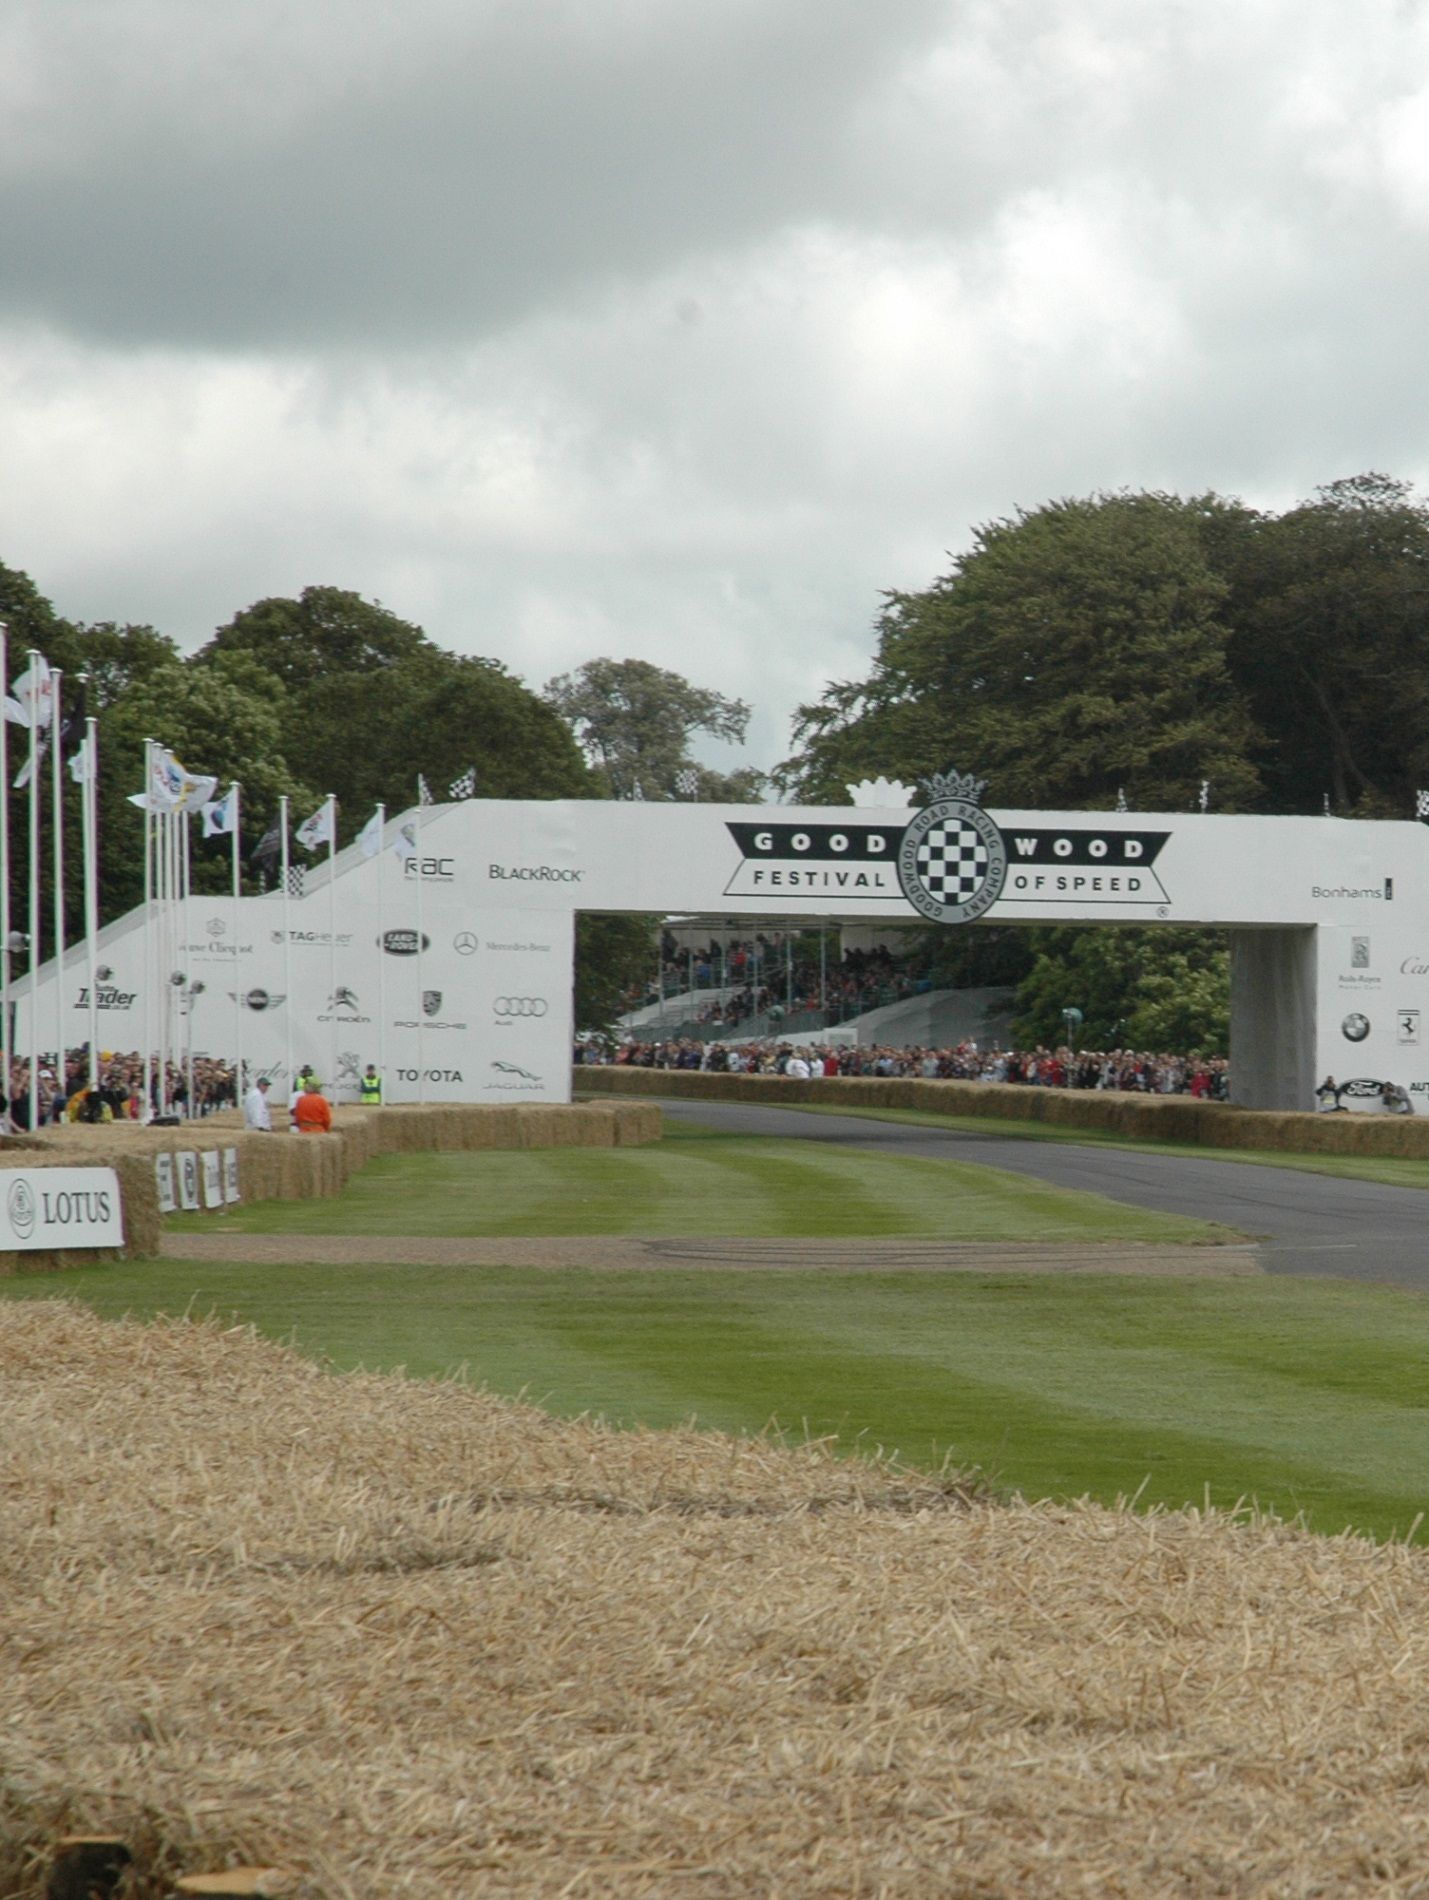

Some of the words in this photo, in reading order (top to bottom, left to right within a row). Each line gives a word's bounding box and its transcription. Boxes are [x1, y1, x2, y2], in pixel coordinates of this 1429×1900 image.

[914, 804, 949, 833] ROAD
[957, 804, 1000, 849] RACING
[753, 871, 885, 887] FESTIVAL
[1014, 875, 1045, 890] OF
[1056, 876, 1141, 891] SPEED
[903, 838, 943, 917] GOODWOOD
[961, 857, 1003, 918] COMPANY
[1311, 886, 1382, 898] Bonhams
[79, 988, 137, 1004] Tader
[397, 1069, 464, 1082] TOYOTA
[42, 1191, 111, 1224] LOTUS
